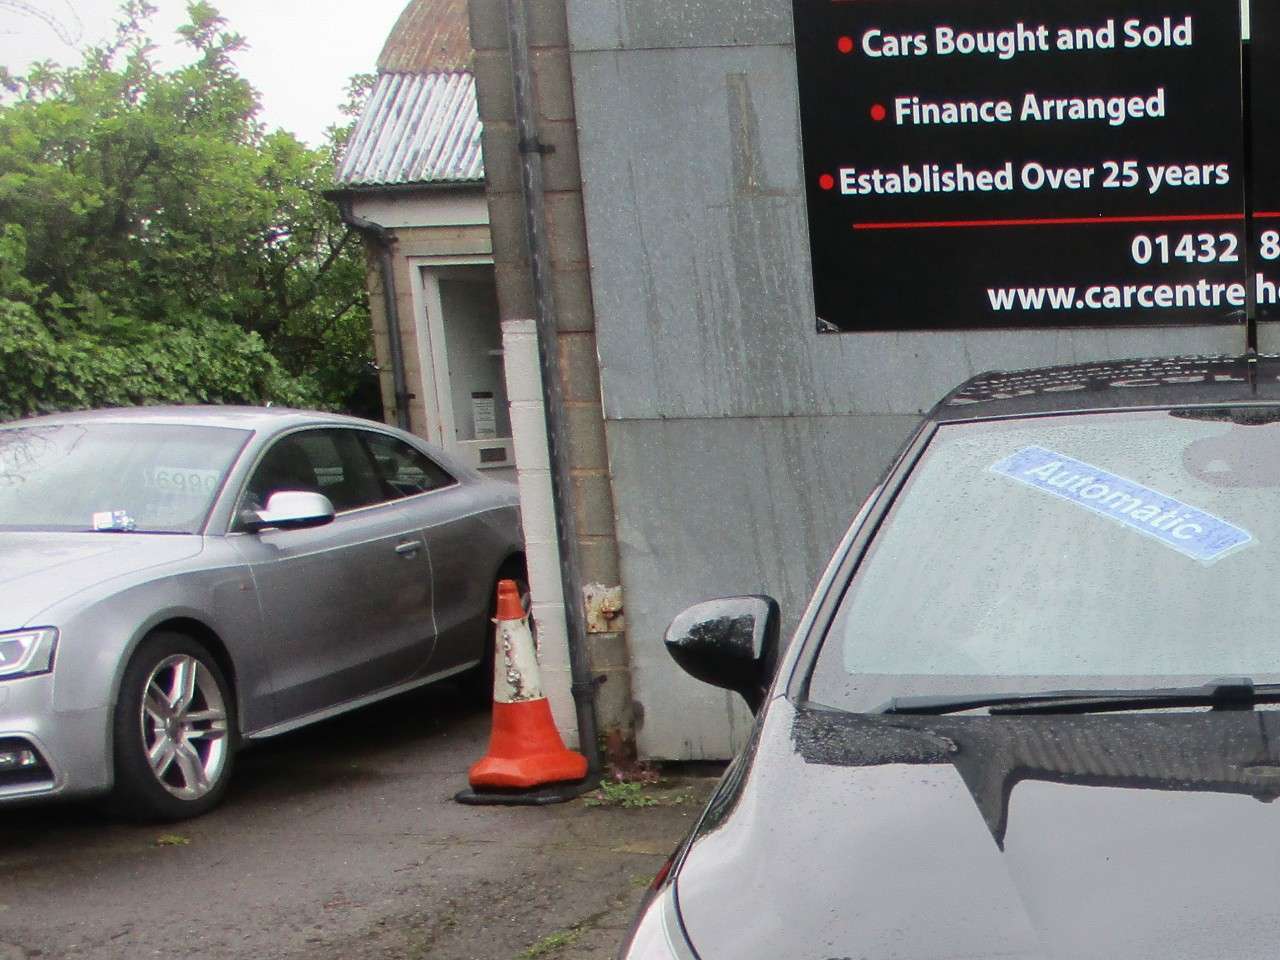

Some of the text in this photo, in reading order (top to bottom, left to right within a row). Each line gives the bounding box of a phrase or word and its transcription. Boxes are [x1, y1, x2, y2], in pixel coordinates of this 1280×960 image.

[861, 16, 1193, 60] Cars Bought and Sold
[894, 88, 1165, 126] Finance Arranged
[839, 160, 1230, 195] Established Over 25 years
[1131, 232, 1239, 265] 01432
[1028, 459, 1204, 541] Automatic
